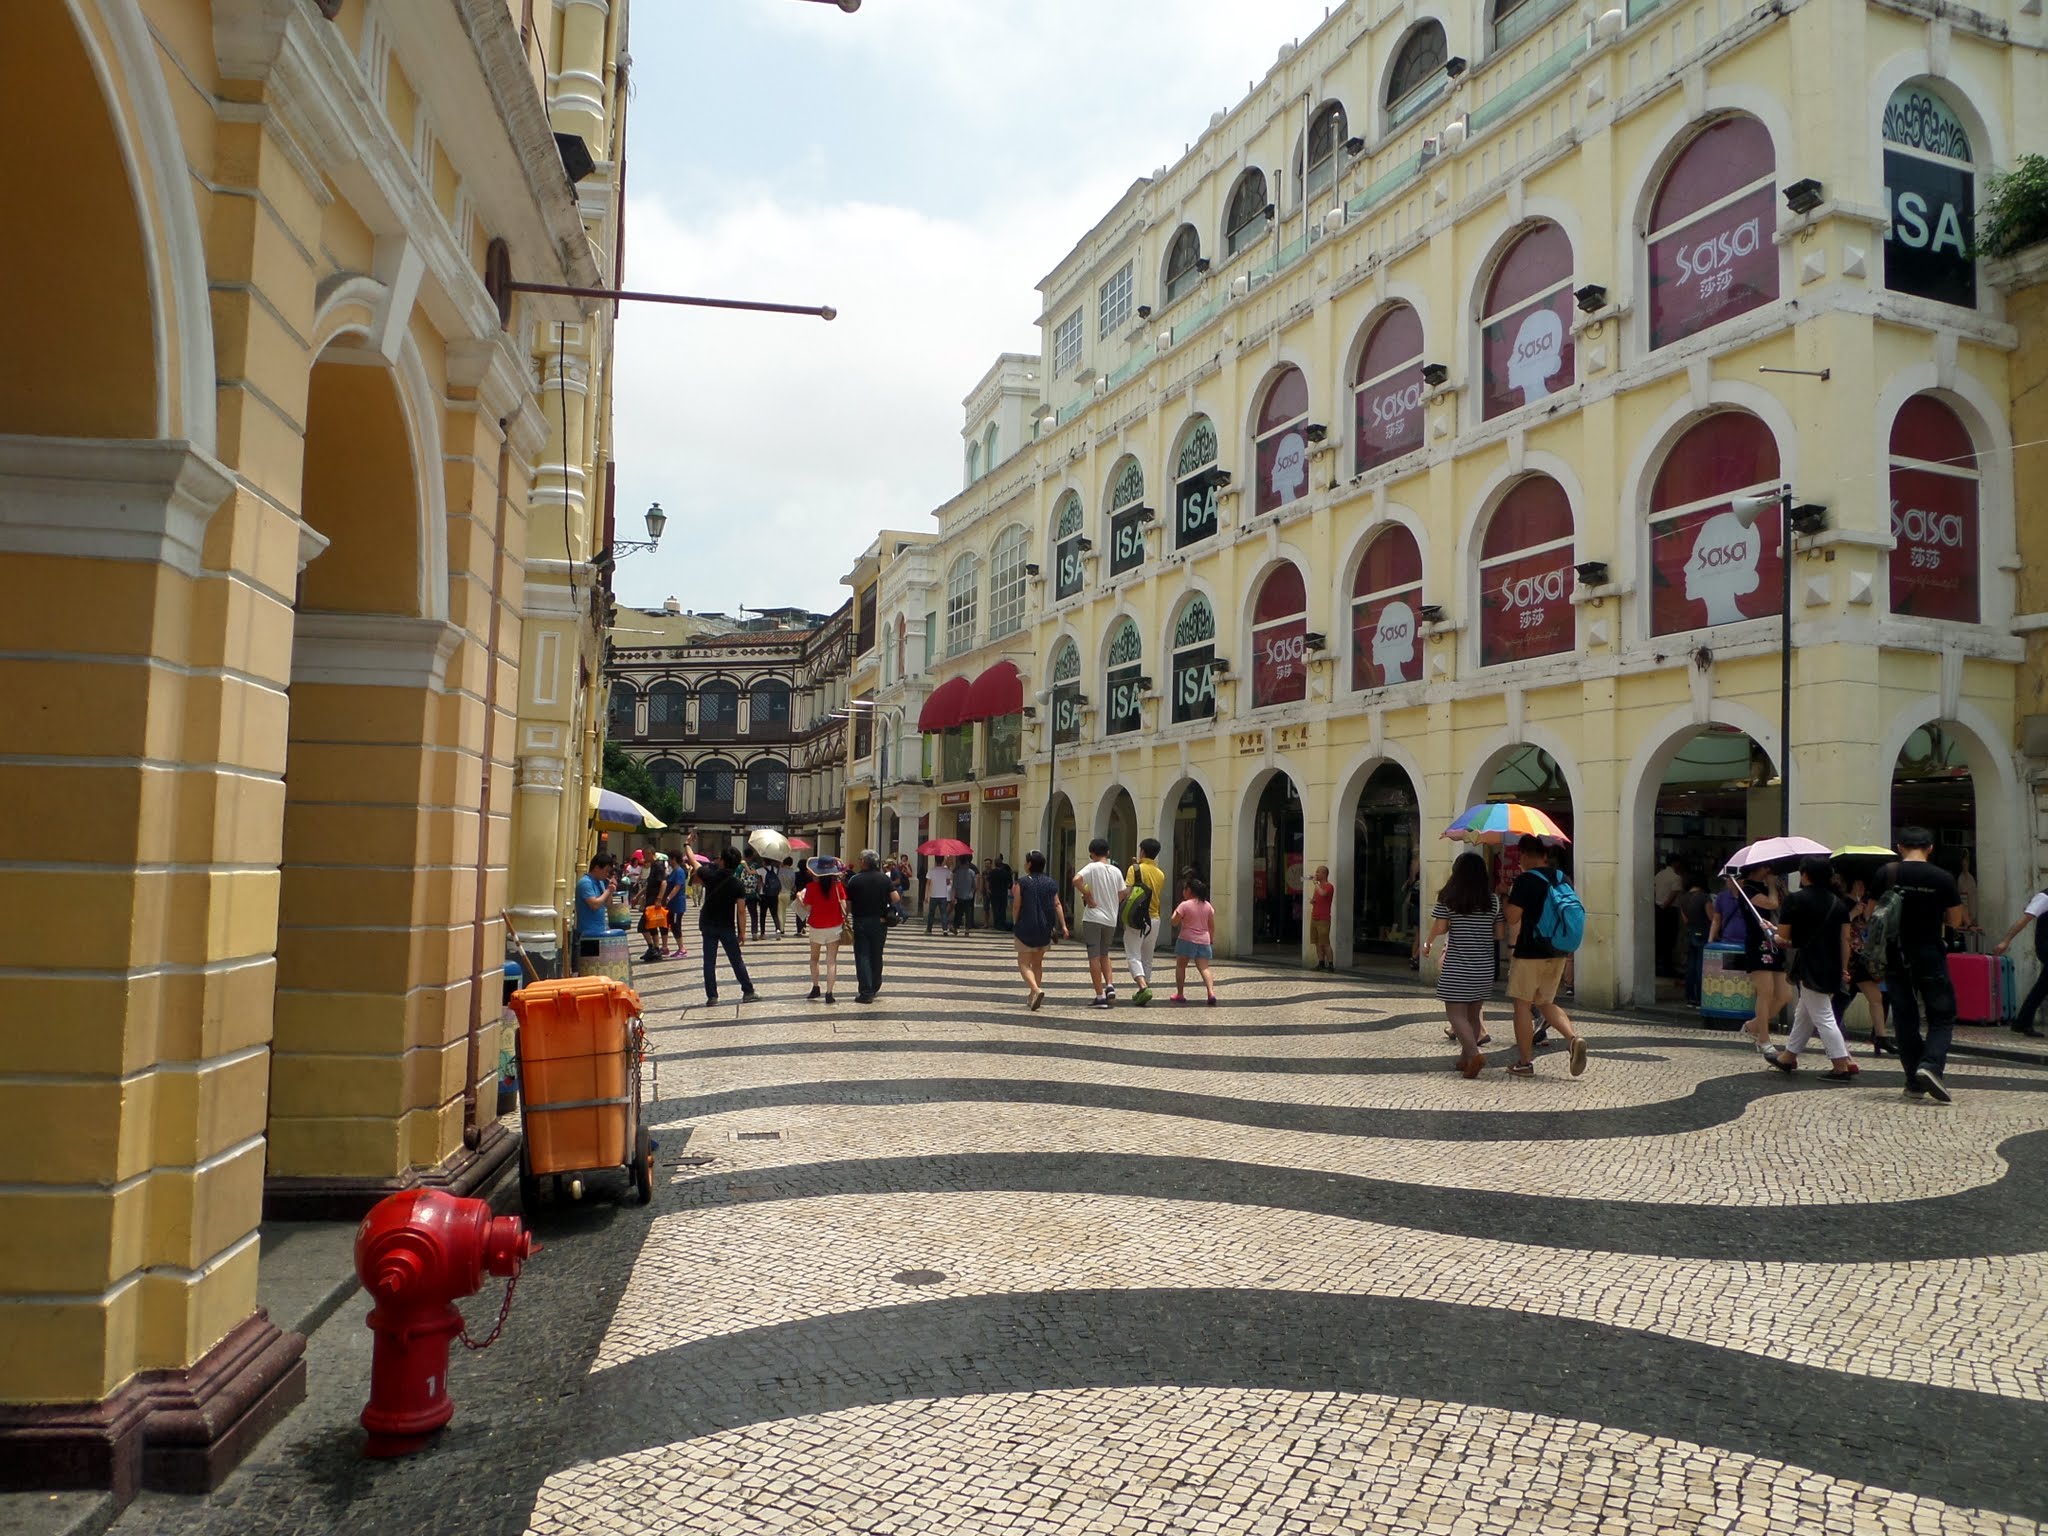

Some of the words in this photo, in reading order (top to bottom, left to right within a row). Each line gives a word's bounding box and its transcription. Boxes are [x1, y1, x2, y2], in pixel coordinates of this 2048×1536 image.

[1884, 186, 1967, 258] ISA
[1700, 268, 1733, 299] 莎莎
[1385, 418, 1405, 440] 莎莎
[1182, 486, 1218, 532] ISA
[1116, 521, 1144, 561] ISA
[1911, 546, 1940, 569] 莎莎
[1520, 607, 1544, 629] 莎莎
[1112, 683, 1141, 720] ISA
[1178, 664, 1215, 706] ISA
